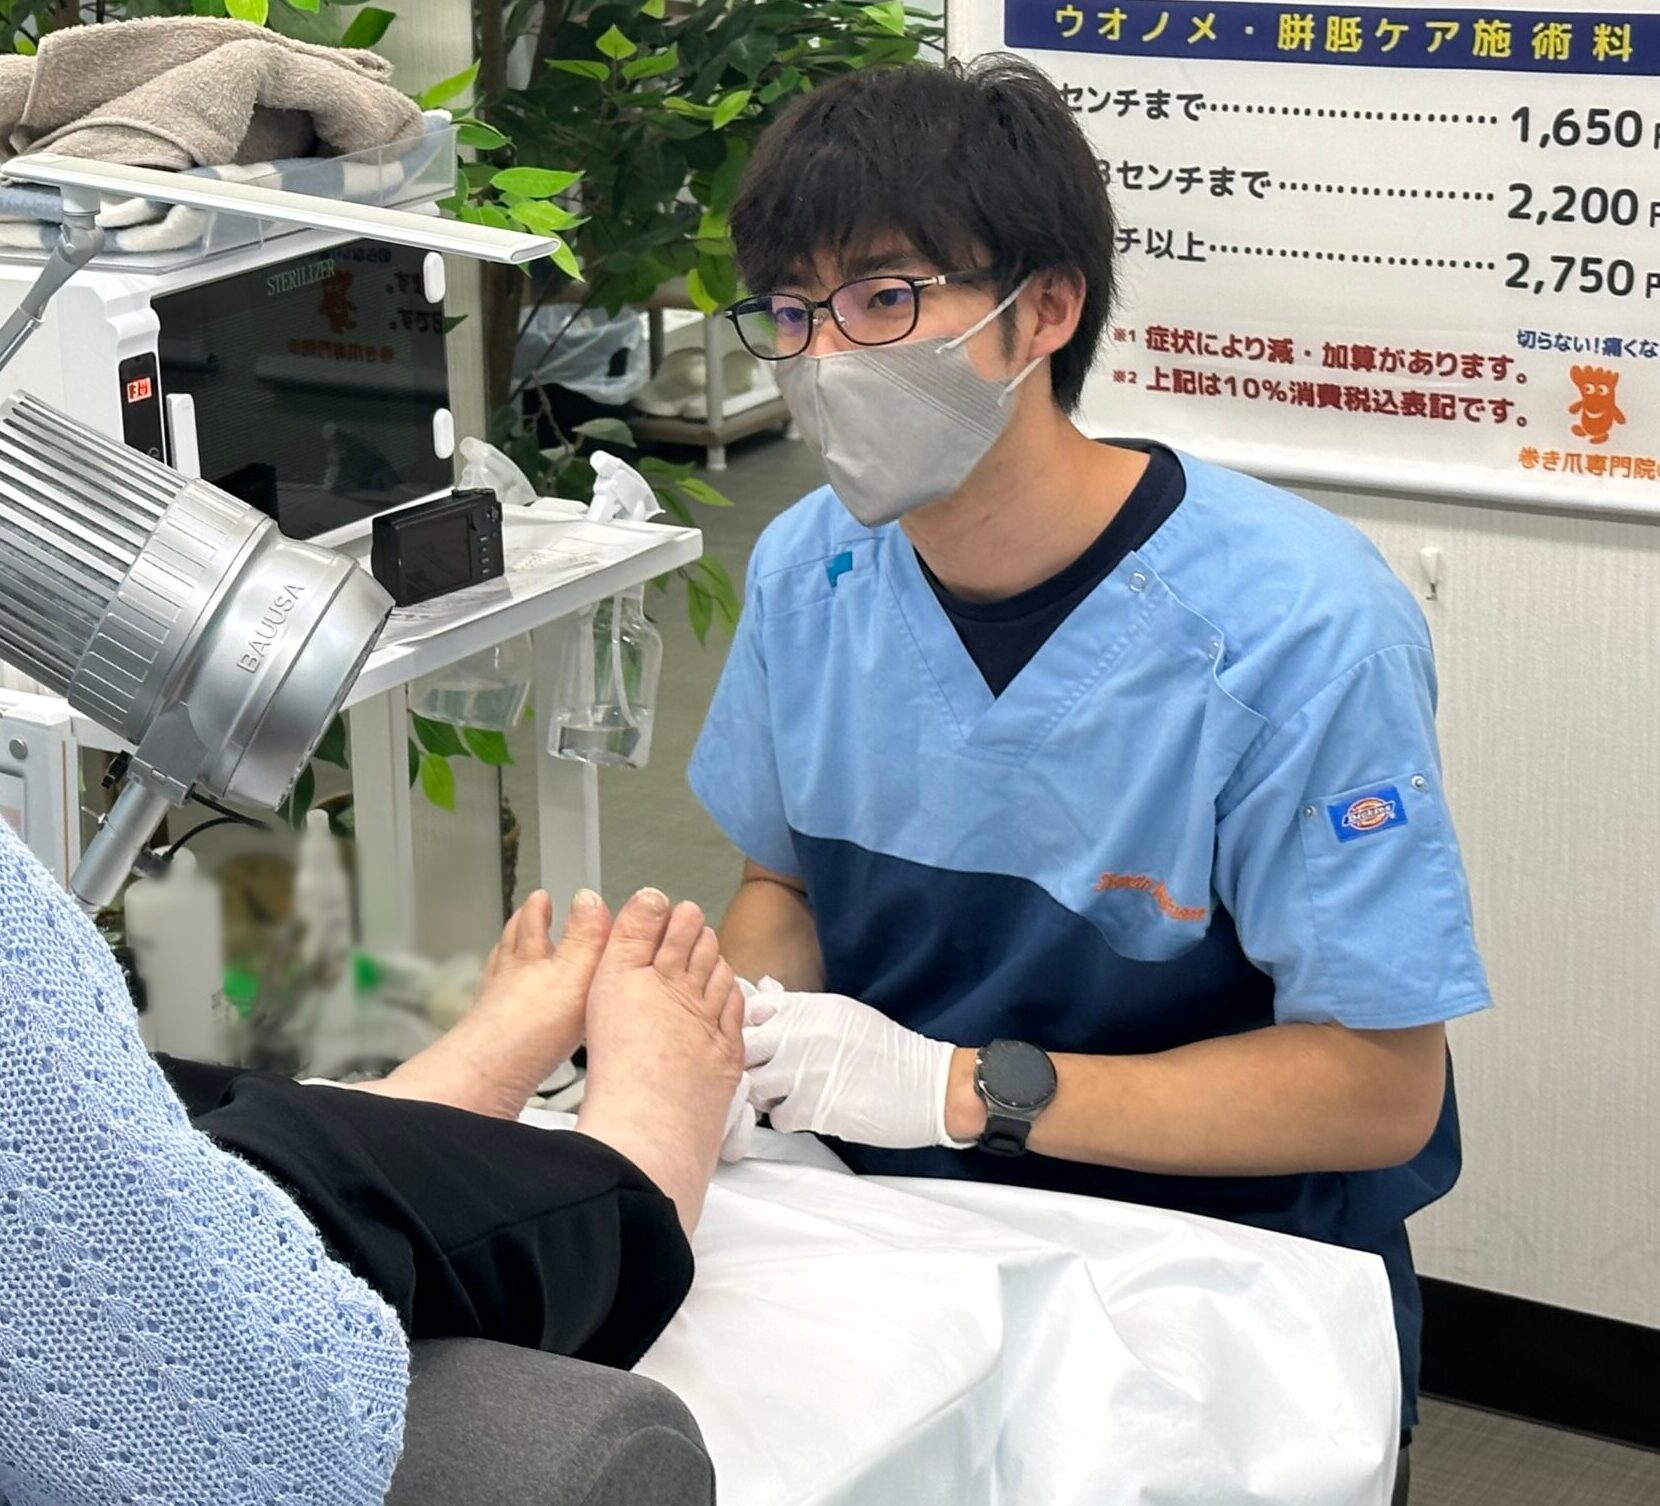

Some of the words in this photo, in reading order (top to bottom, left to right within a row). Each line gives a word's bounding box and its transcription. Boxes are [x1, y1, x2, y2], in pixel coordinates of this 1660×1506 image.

[1512, 106, 1643, 149] 1,650
[1507, 183, 1639, 226] 2,200
[266, 258, 336, 296] STERILIZER
[1505, 252, 1635, 297] 2,750
[1518, 446, 1660, 480] 巻き爪専門院
[236, 585, 305, 674] BAUUSA
